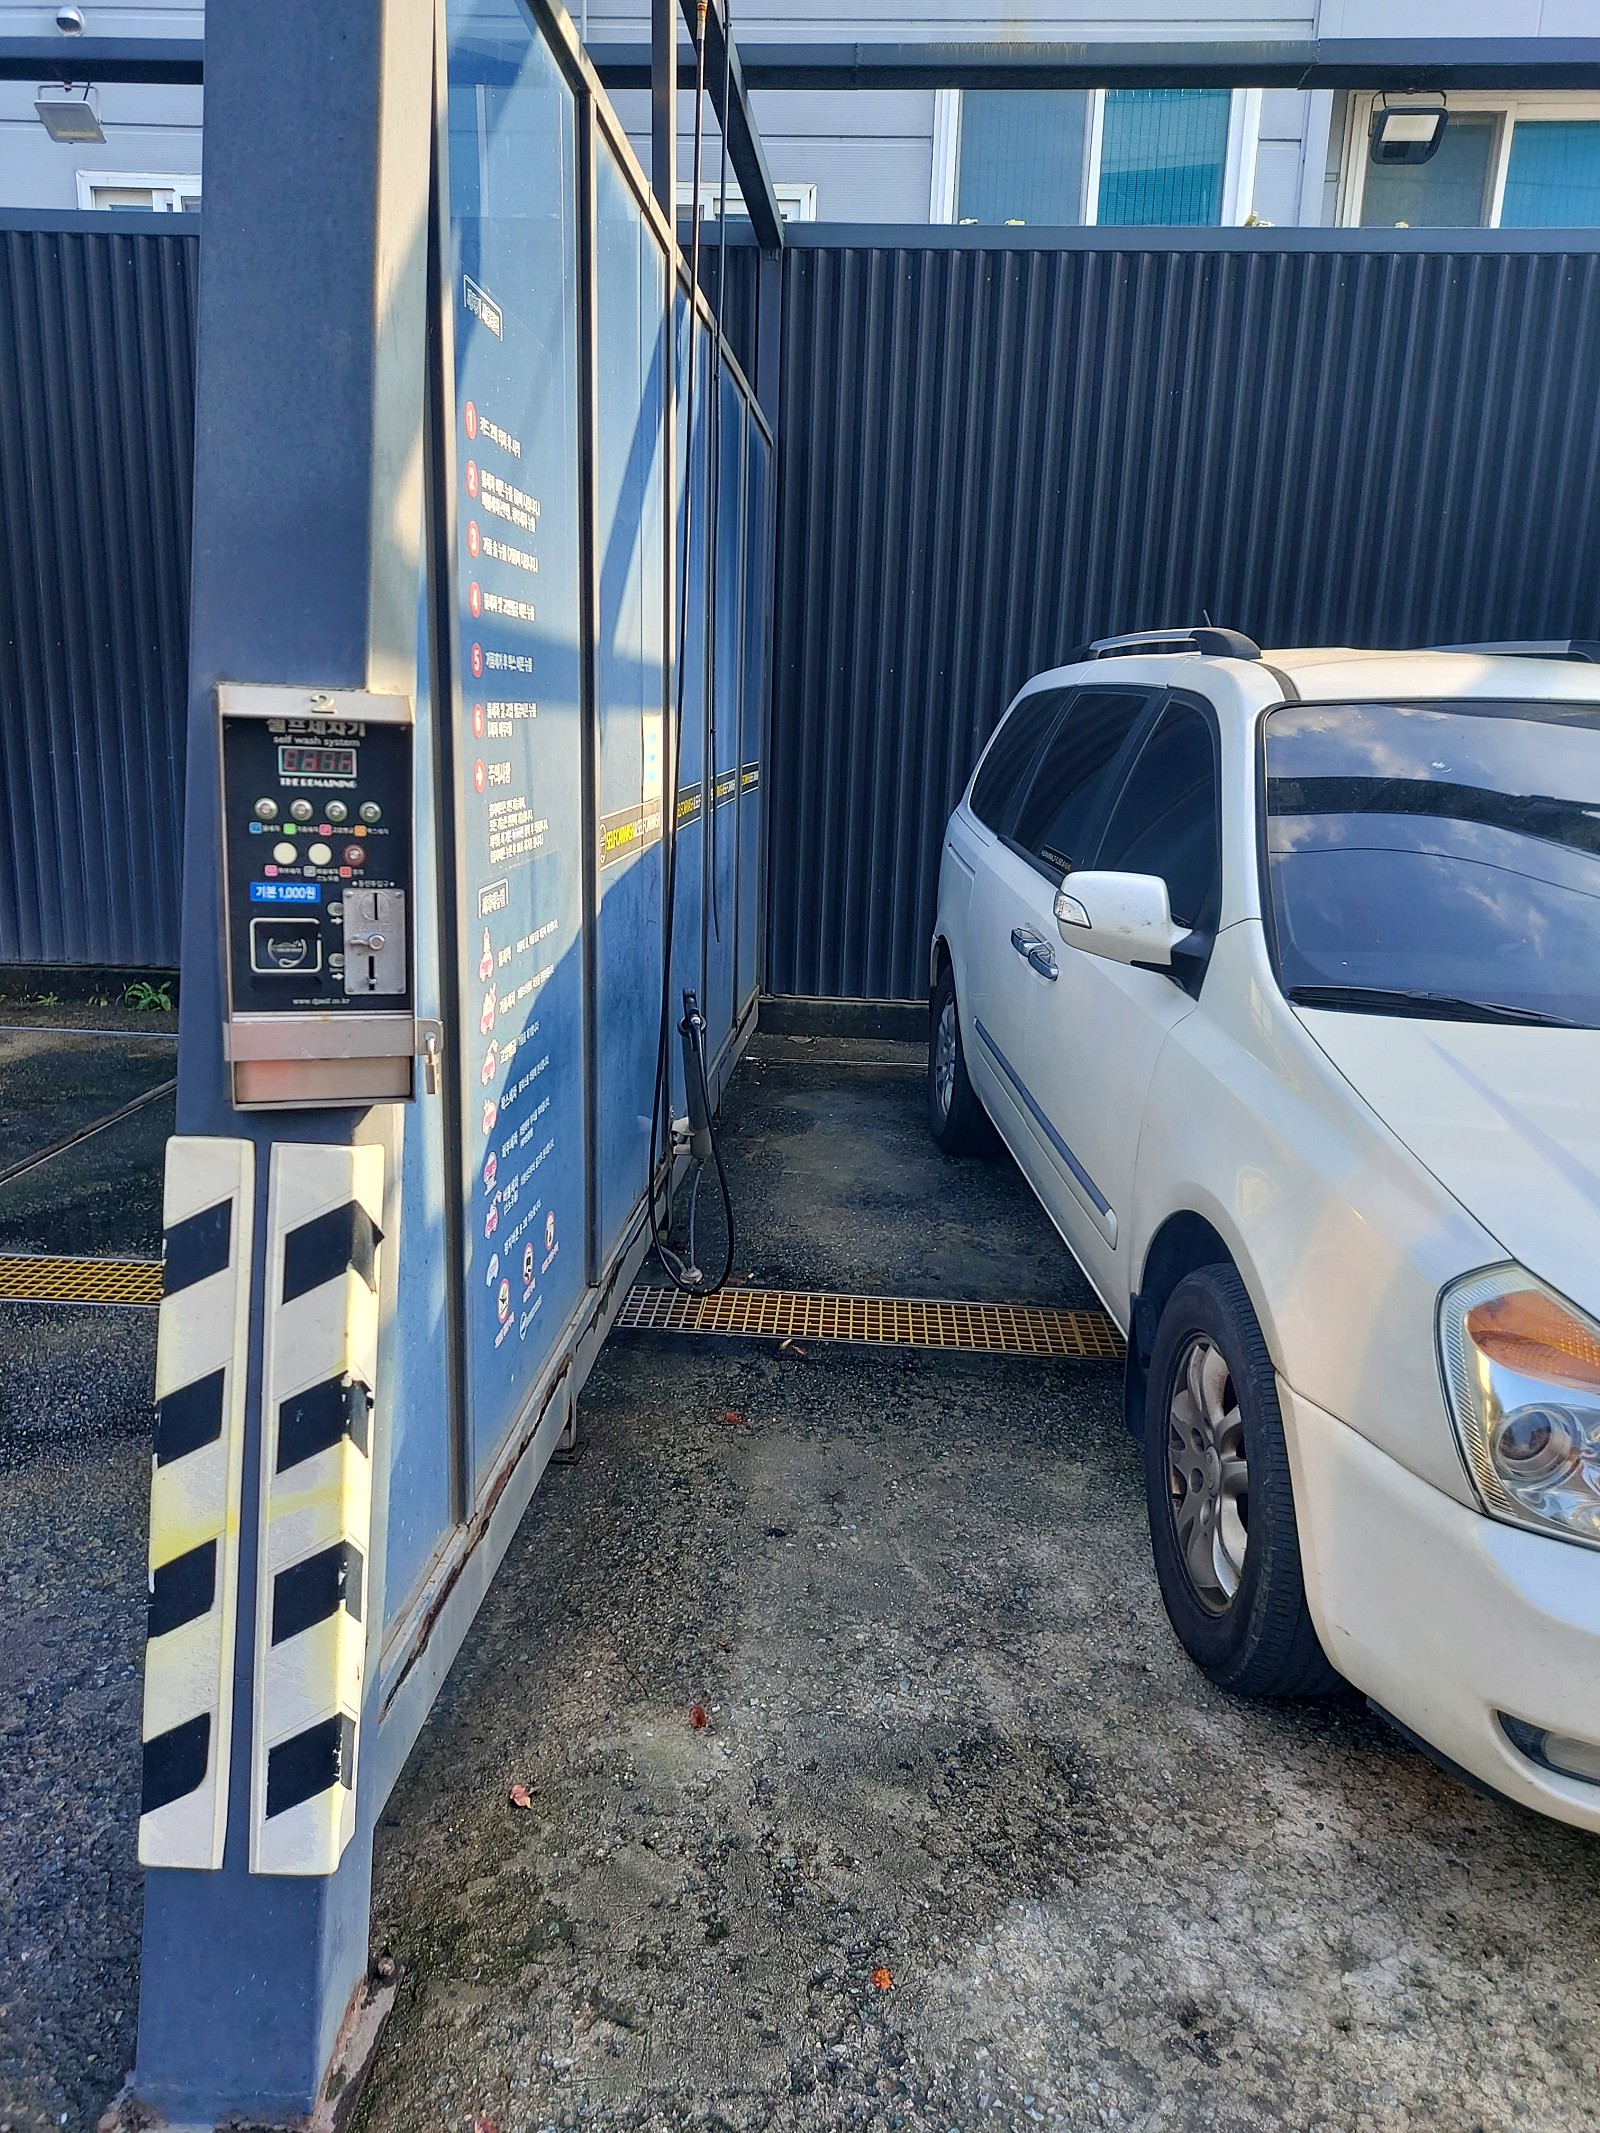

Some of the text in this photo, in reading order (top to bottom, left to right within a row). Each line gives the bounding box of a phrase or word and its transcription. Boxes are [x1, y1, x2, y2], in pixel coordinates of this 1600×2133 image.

[310, 692, 336, 712] 2
[266, 718, 366, 737] 셀프세차기
[272, 735, 361, 747] self wash system
[256, 886, 316, 900] 기본 1,000원
